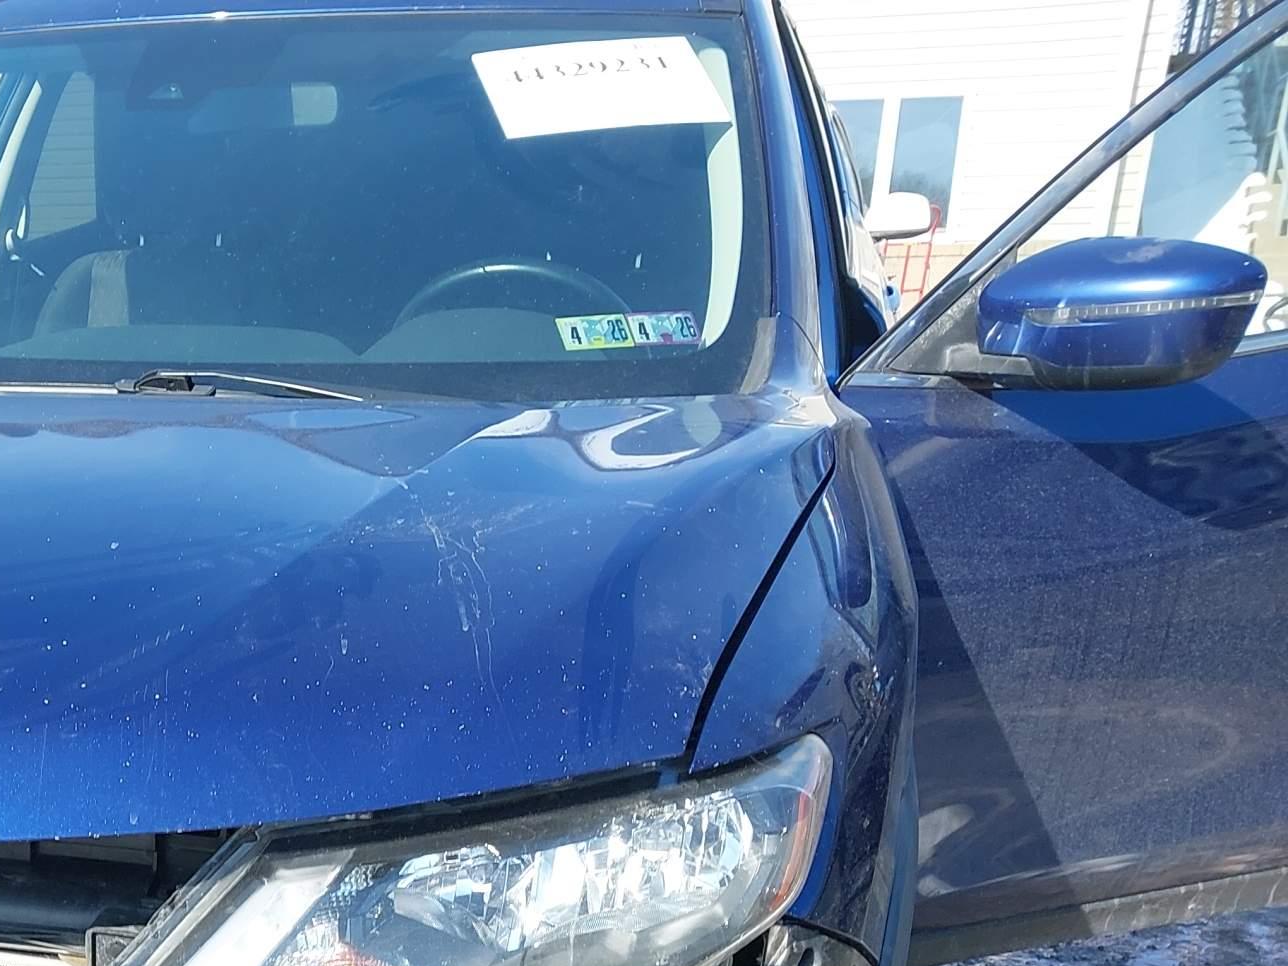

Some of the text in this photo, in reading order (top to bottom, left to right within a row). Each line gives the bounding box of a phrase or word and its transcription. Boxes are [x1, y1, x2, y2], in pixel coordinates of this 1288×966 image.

[571, 318, 629, 345] 4 26
[638, 315, 697, 341] 4 26
